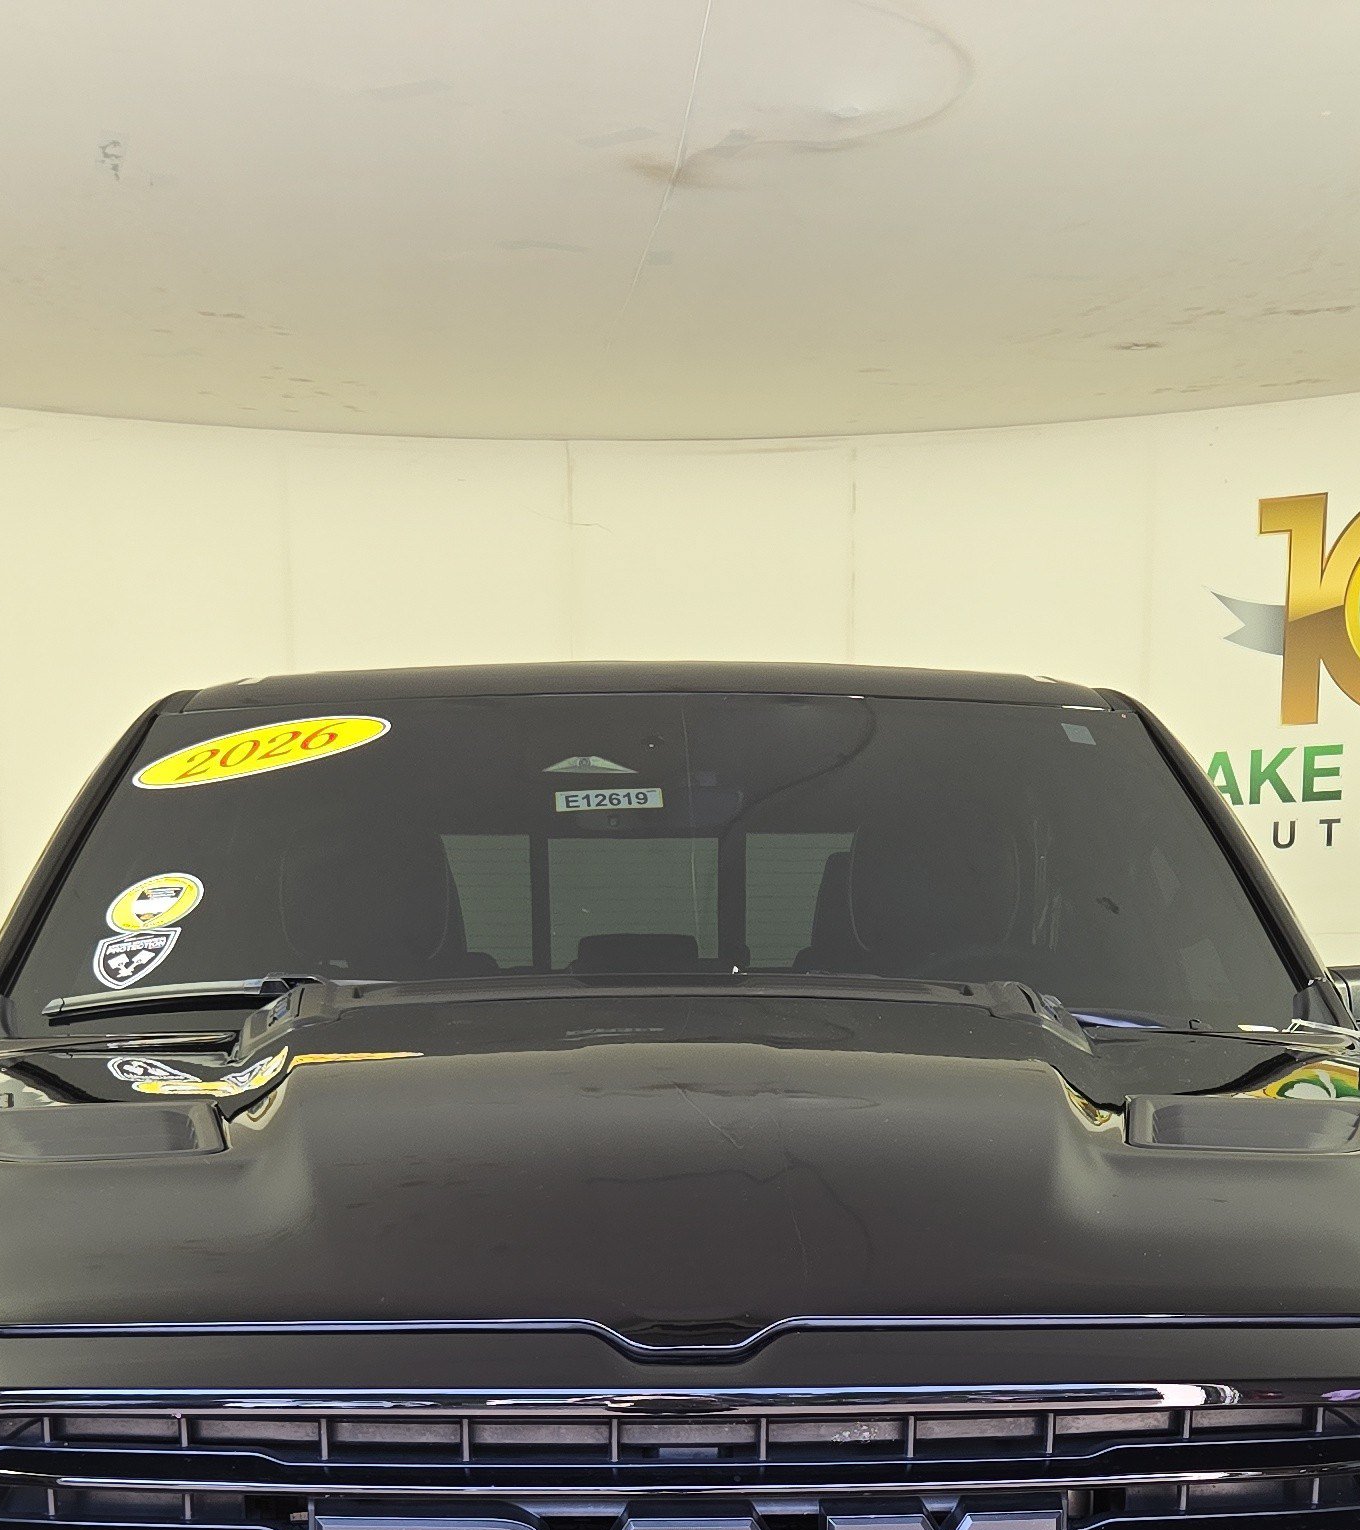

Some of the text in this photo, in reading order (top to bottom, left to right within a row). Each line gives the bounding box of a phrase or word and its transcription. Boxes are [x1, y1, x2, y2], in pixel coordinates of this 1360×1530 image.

[173, 722, 347, 781] 2026
[1207, 744, 1344, 807] AKE
[565, 792, 648, 808] E12619
